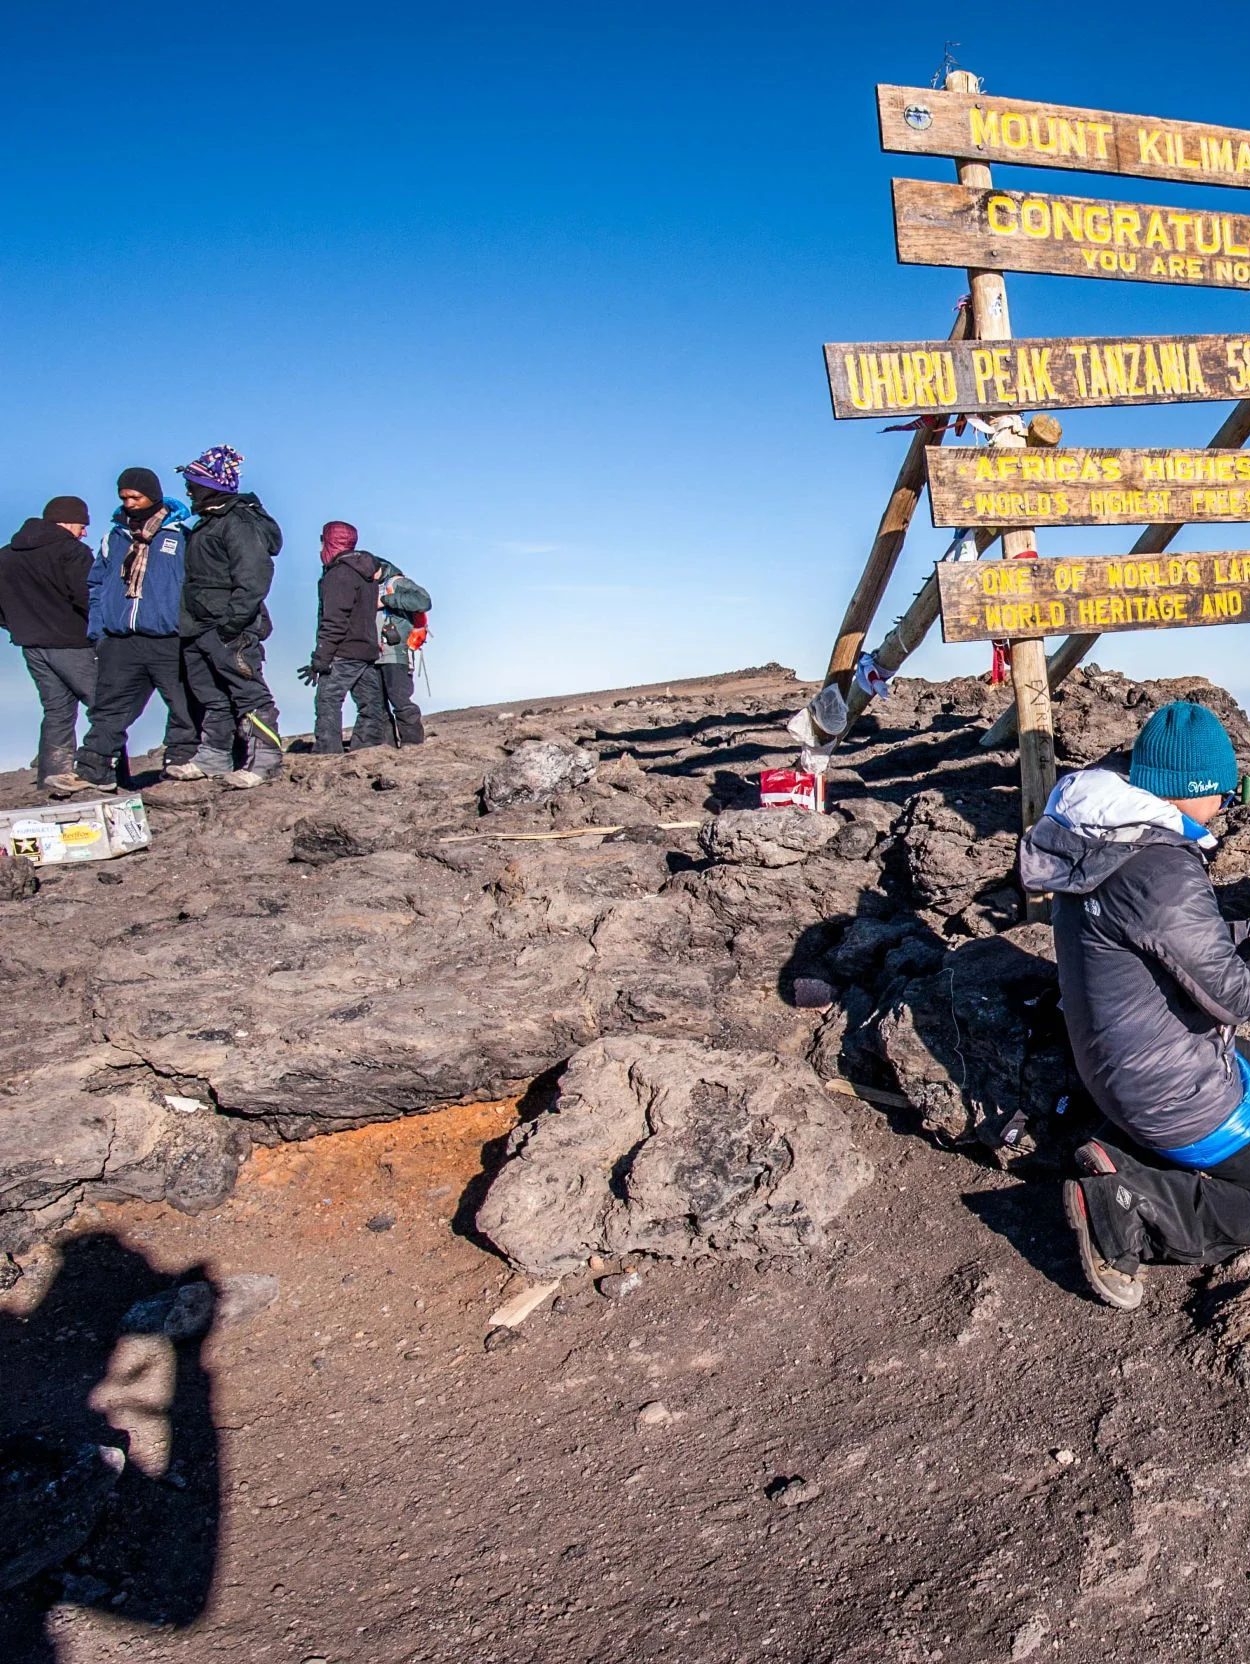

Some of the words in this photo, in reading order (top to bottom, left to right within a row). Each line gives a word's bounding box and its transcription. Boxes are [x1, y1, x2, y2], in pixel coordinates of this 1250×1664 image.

[970, 107, 1112, 159] MOUNT
[1081, 248, 1137, 273] YOU
[1151, 256, 1204, 279] ARE
[844, 350, 958, 410] UHURU
[971, 347, 1060, 403] PEAK
[1067, 343, 1207, 398] TANZANIA
[1089, 490, 1172, 516] HIGHEST
[981, 568, 1033, 595] ONE
[1054, 564, 1087, 592] OF
[984, 601, 1066, 631] WORLD
[1079, 594, 1188, 625] HERITAGE
[1202, 590, 1243, 617] AND
